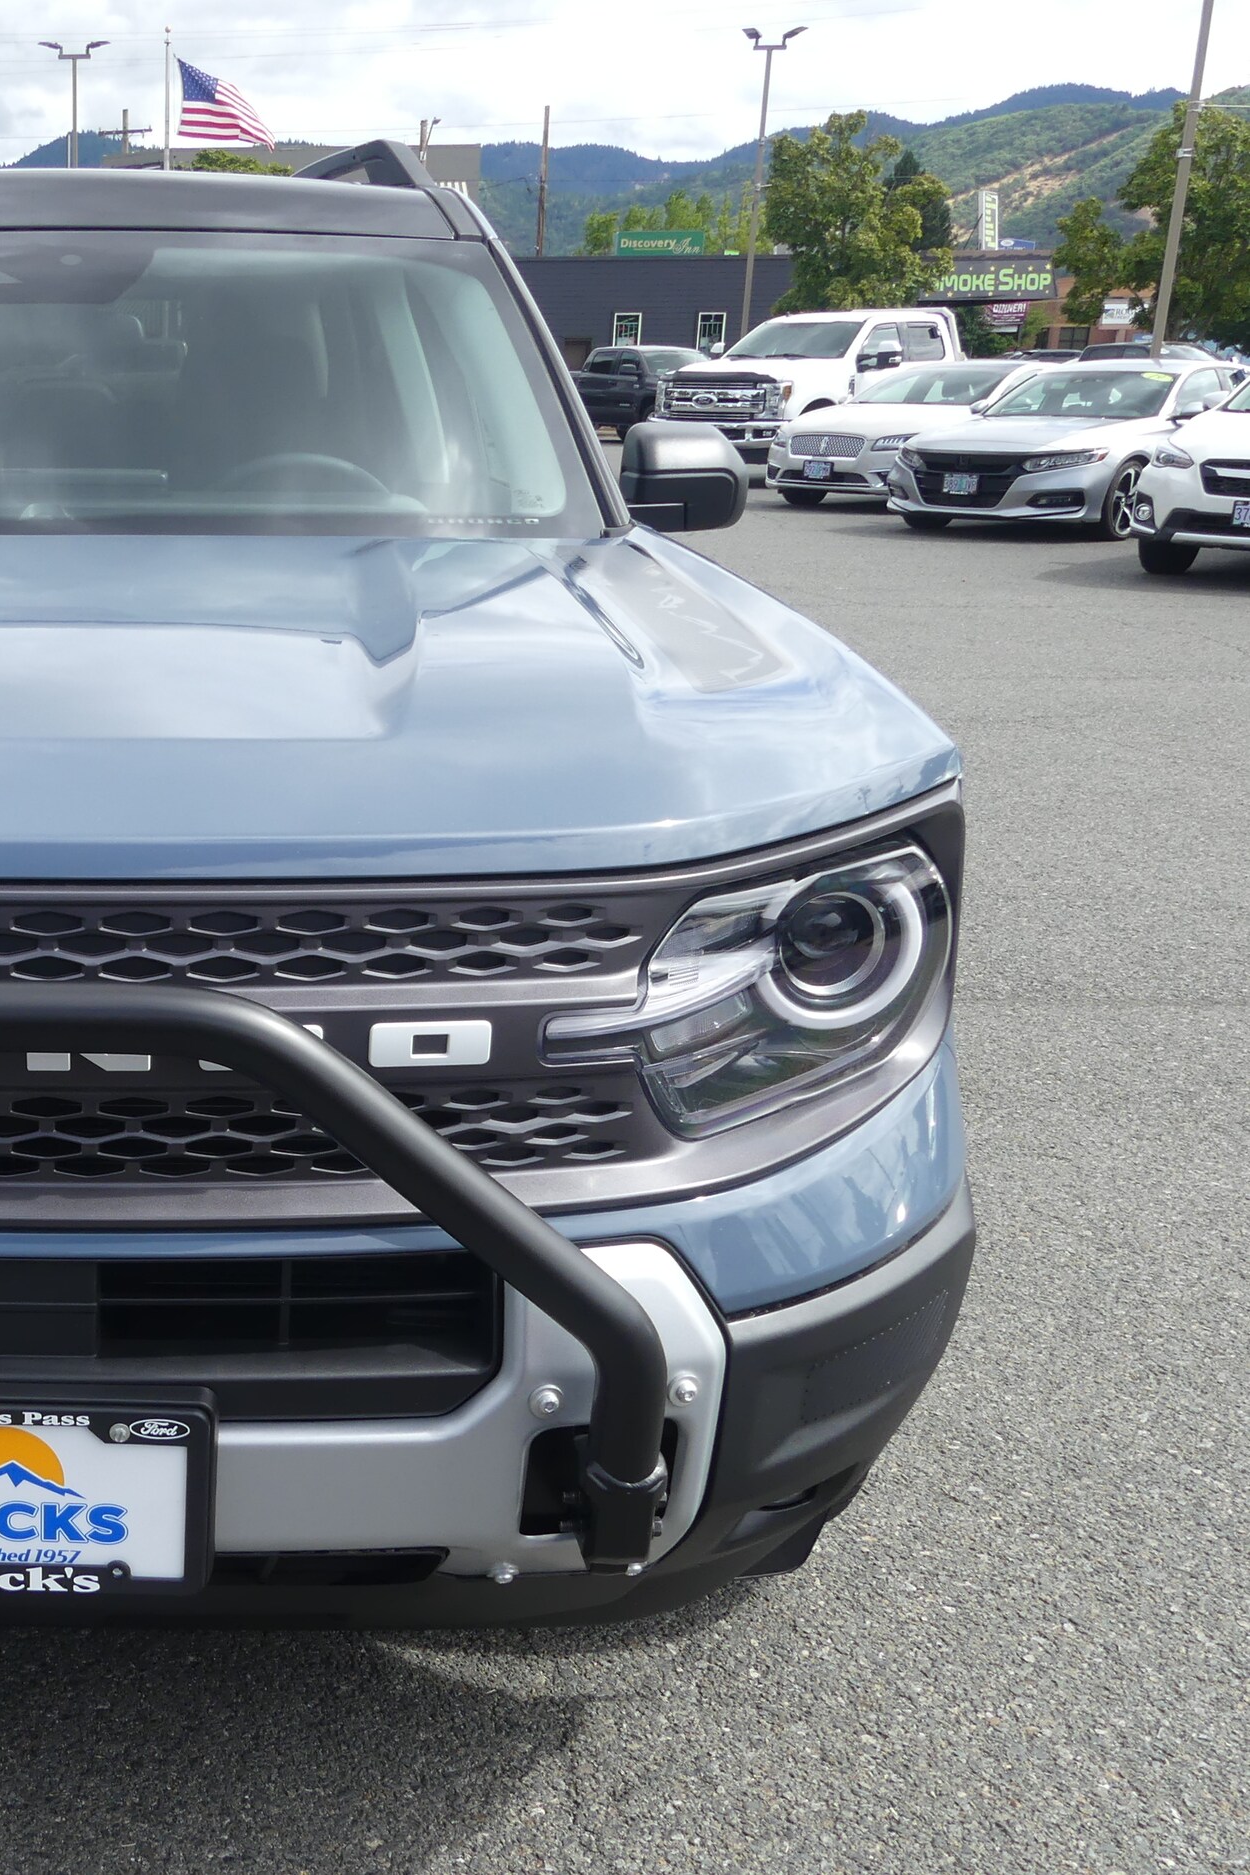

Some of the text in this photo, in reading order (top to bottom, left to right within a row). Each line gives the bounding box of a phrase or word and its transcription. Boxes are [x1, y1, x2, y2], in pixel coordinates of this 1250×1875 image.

[620, 237, 700, 254] Discovery Inn
[998, 269, 1052, 291] SHOP
[992, 303, 1026, 313] DINNER!
[22, 1411, 90, 1427] Pass
[140, 1421, 178, 1437] Ford
[35, 1548, 82, 1564] 1957
